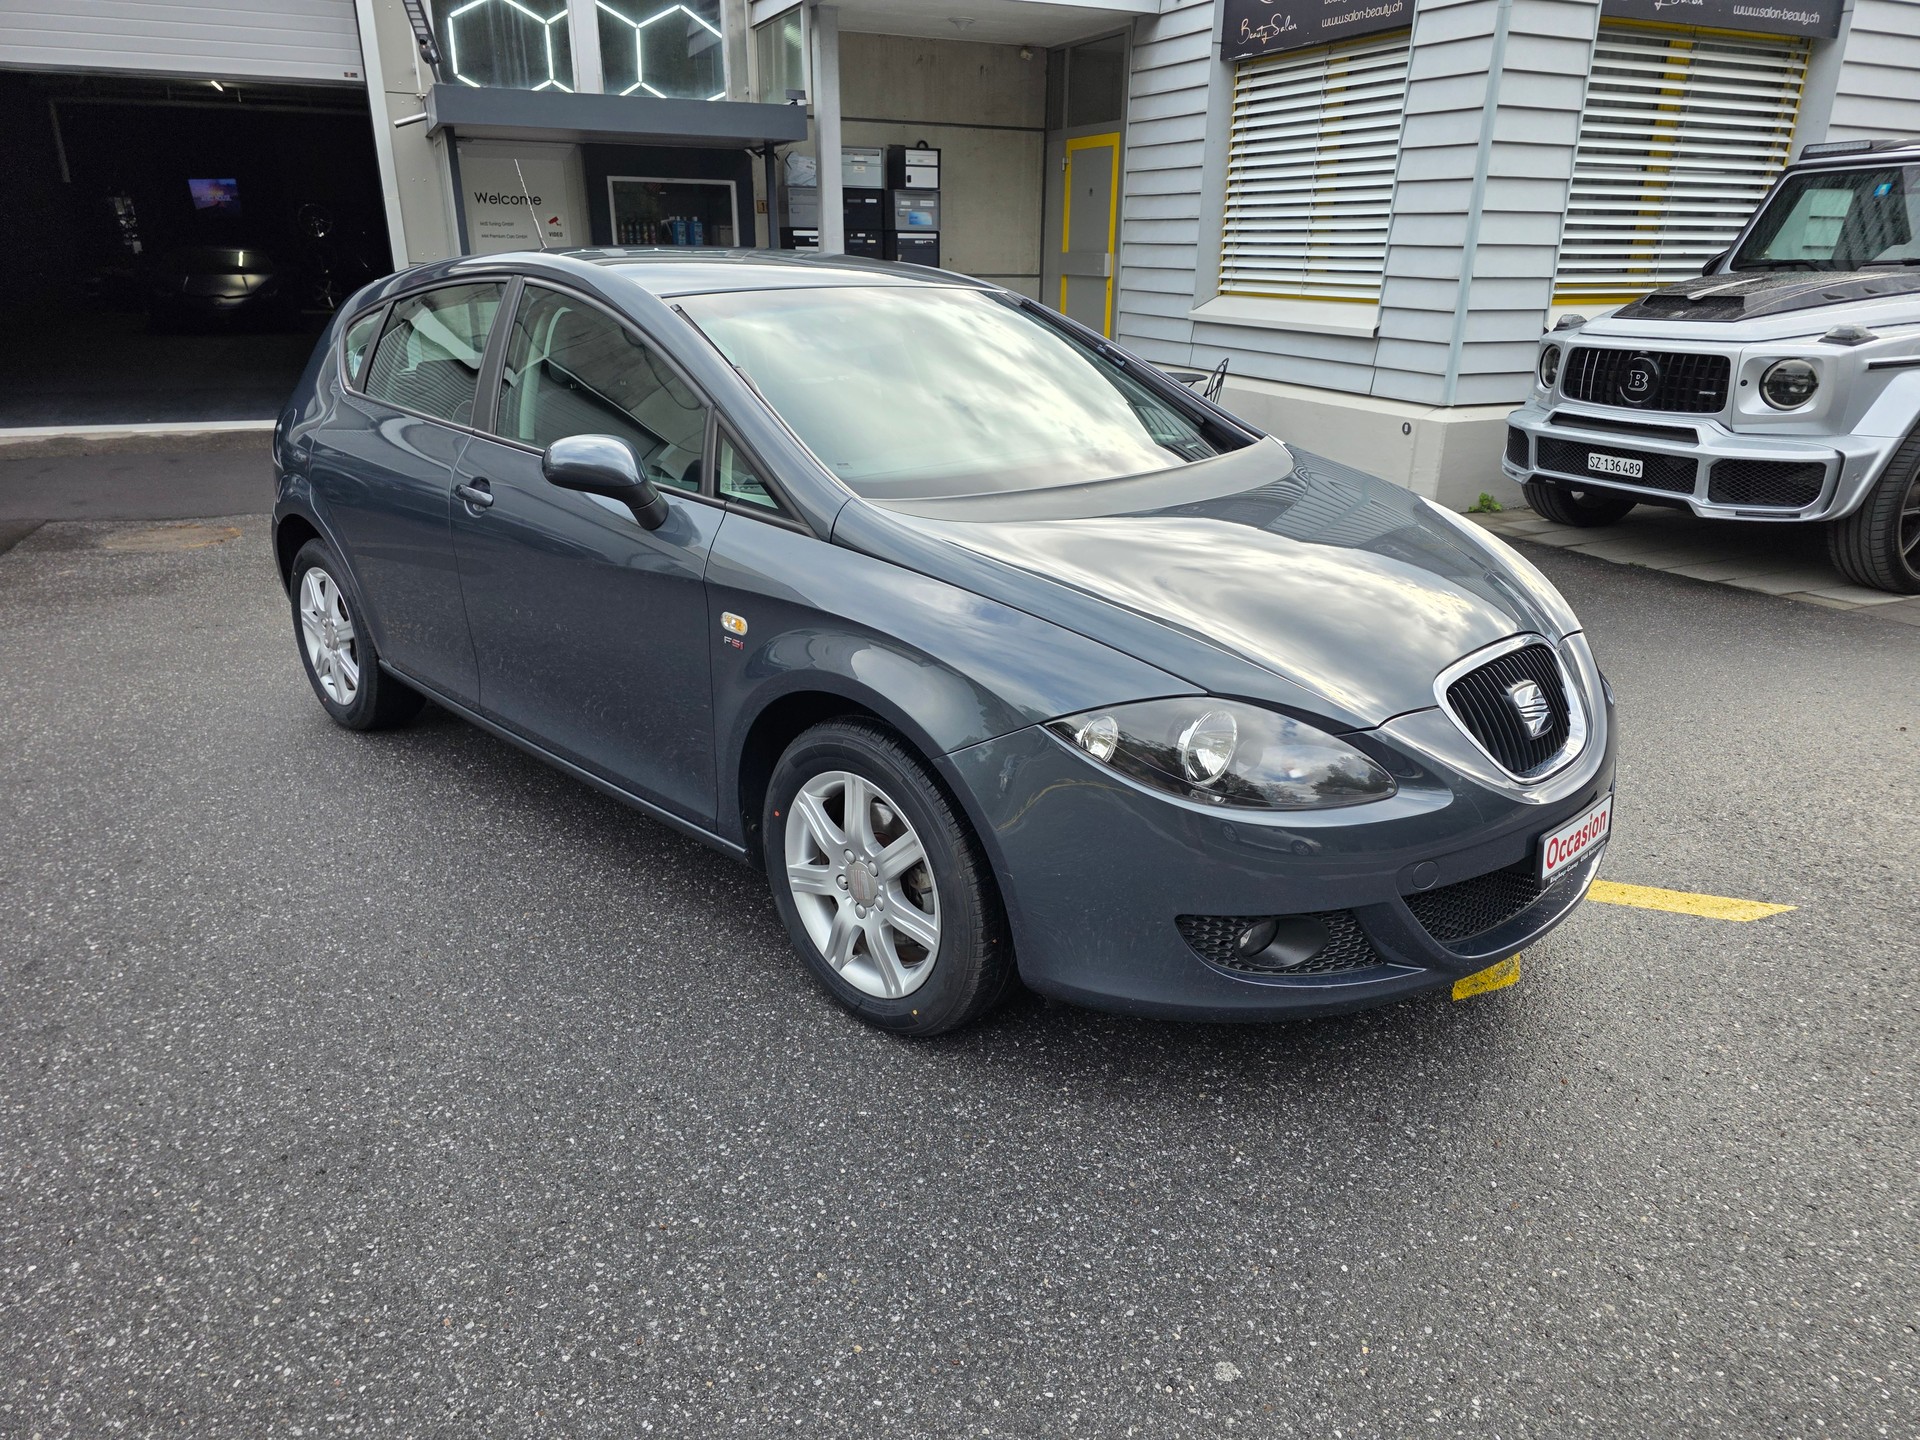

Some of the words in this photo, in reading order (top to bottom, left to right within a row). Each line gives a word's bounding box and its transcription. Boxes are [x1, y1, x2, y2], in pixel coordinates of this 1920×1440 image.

[1321, 1, 1403, 28] www.salon-beauty.ch
[1733, 5, 1820, 26] www.salon-beauty.ch
[1237, 18, 1271, 44] Beauty
[1271, 13, 1297, 36] Salon
[474, 192, 542, 206] Welcome
[1546, 810, 1607, 870] Occasion
